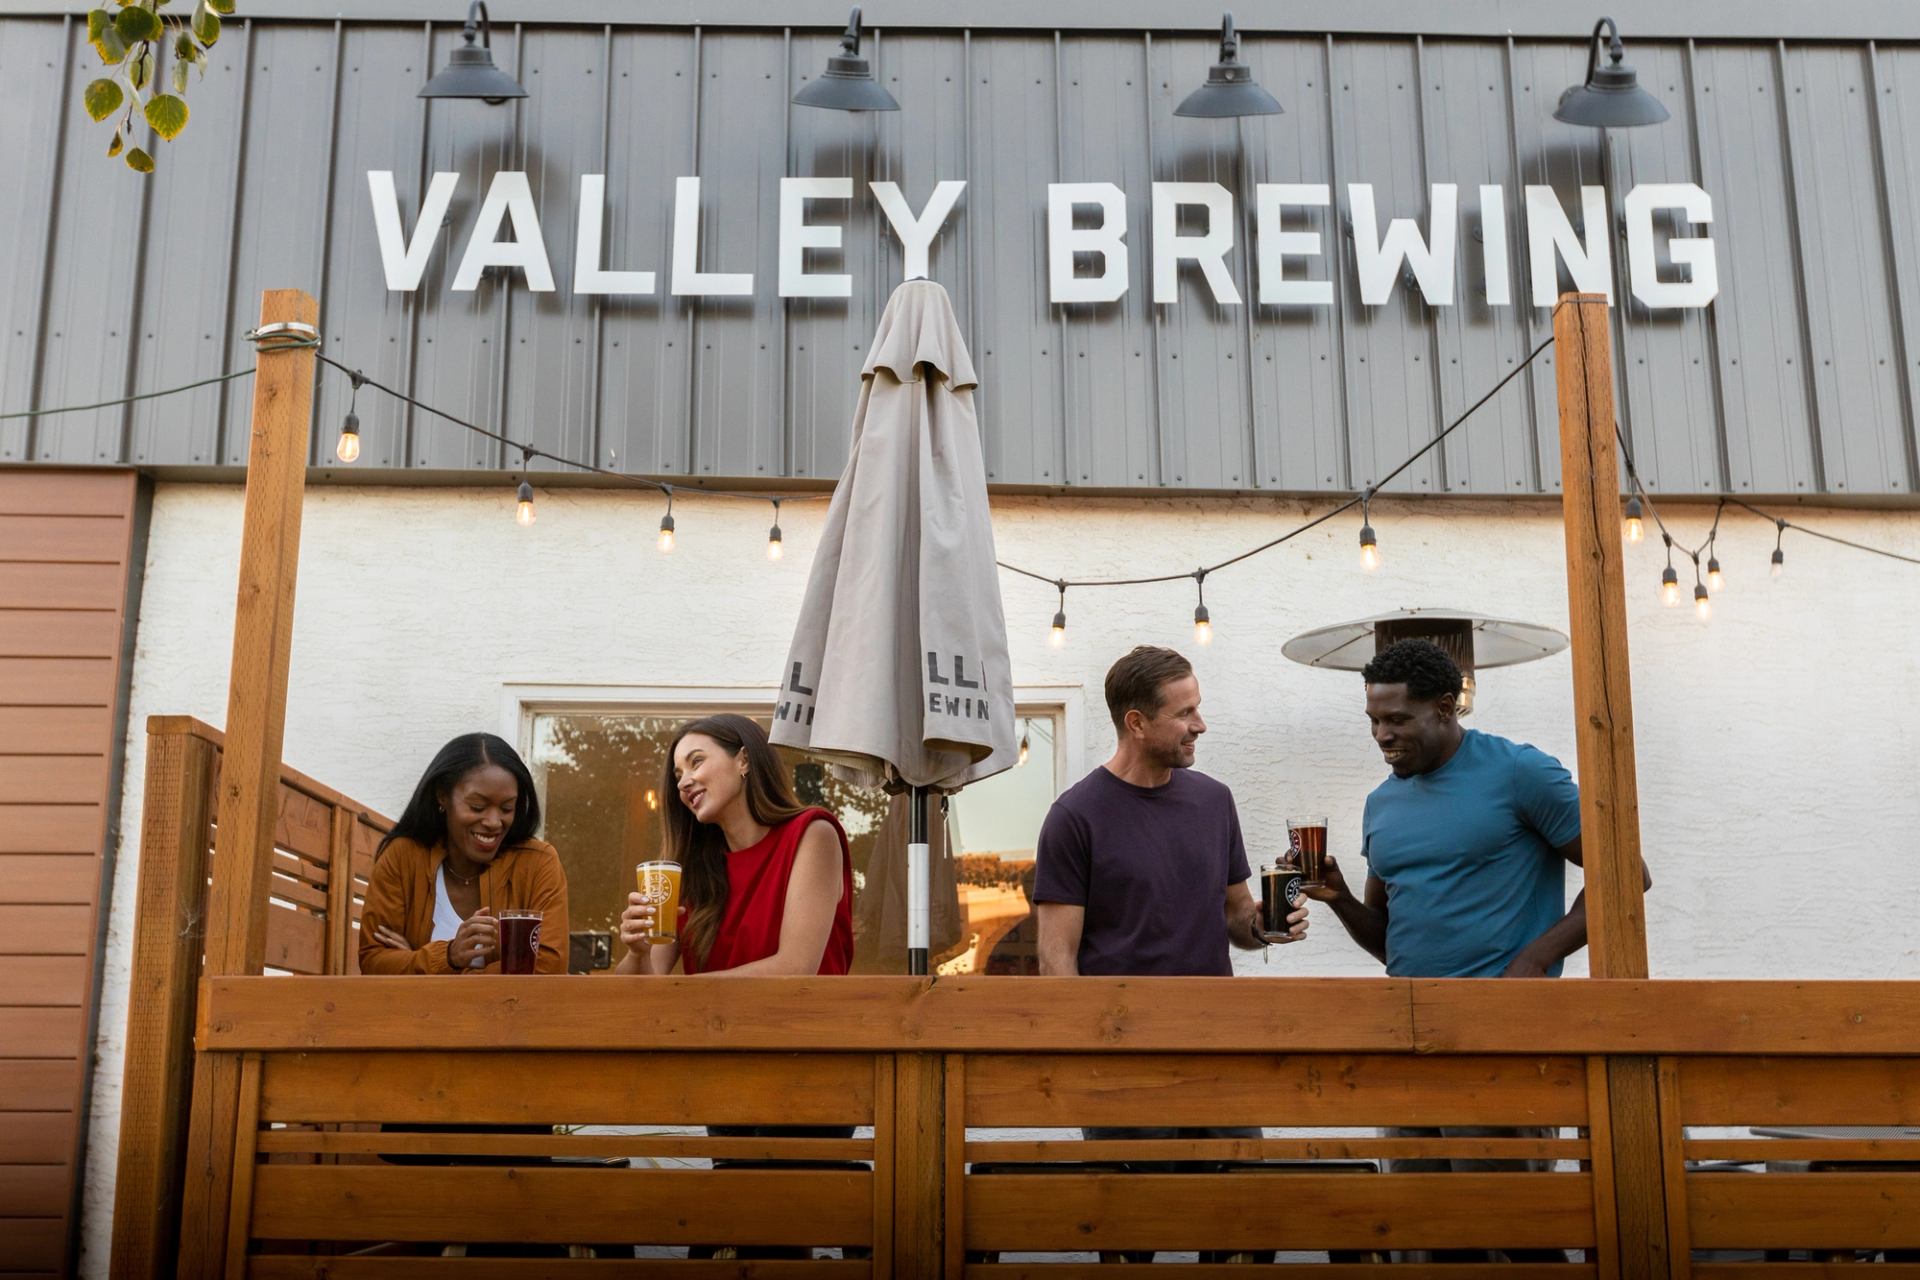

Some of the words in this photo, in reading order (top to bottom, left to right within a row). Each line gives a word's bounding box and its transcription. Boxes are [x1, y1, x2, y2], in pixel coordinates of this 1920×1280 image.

[367, 170, 967, 297] VALLEY
[1048, 182, 1719, 308] BREWING
[928, 651, 987, 692] LL
